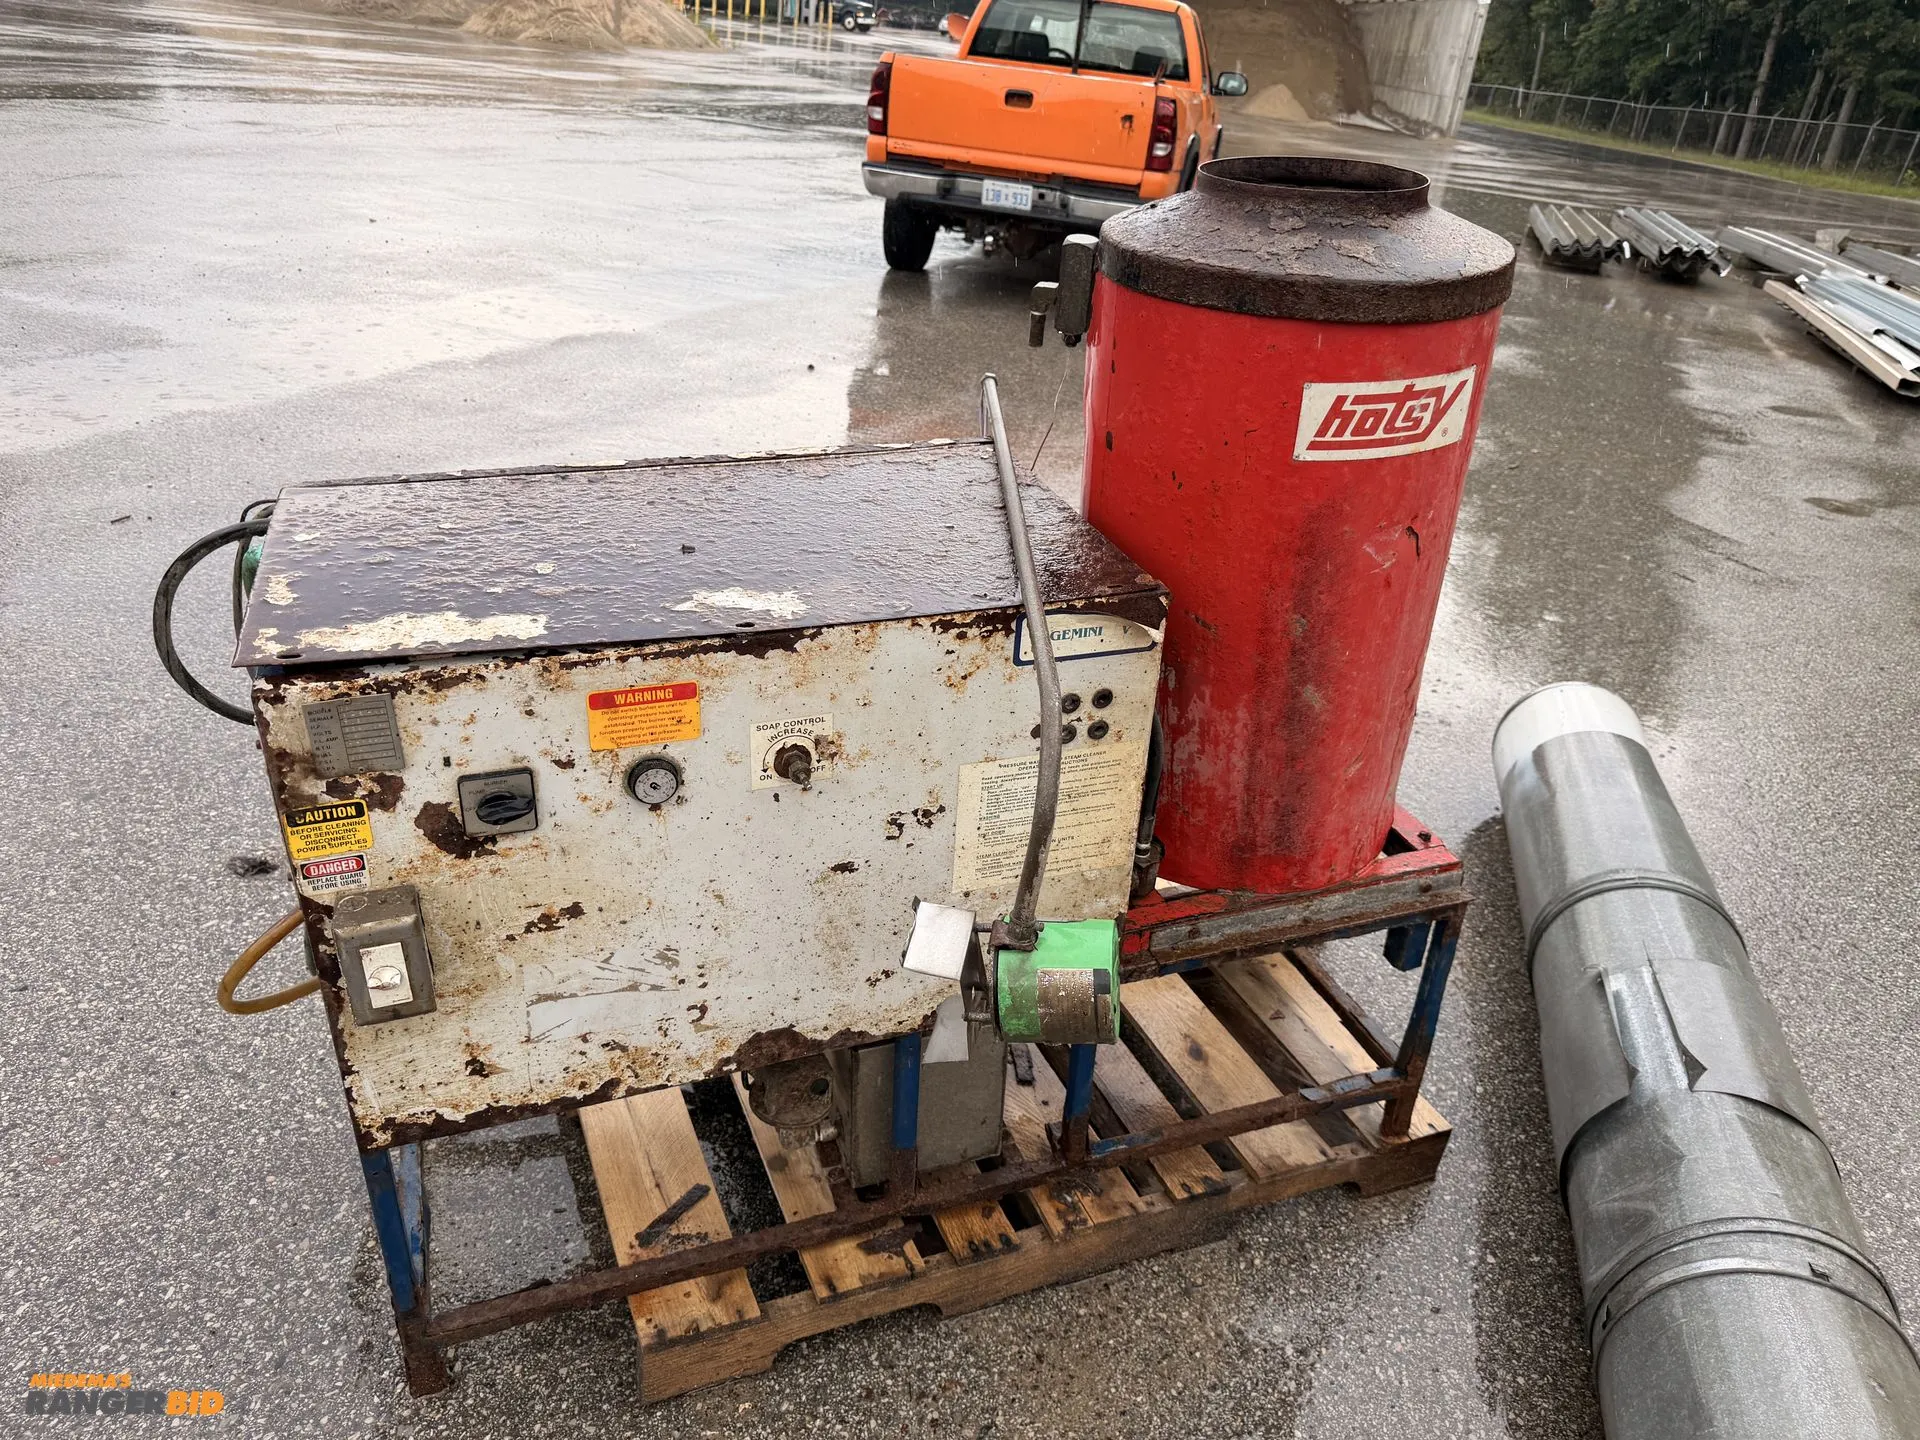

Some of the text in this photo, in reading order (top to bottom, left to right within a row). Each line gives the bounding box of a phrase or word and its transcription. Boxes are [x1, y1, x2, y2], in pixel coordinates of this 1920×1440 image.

[1308, 379, 1469, 450] hotsy
[1050, 626, 1103, 641] GEMINI
[613, 688, 673, 705] WARNING
[756, 716, 826, 732] SOAP CONTROL
[767, 727, 814, 743] INCREASE
[1082, 750, 1106, 758] CLEANER
[810, 765, 826, 774] OFF
[295, 806, 356, 824] CAUTION
[290, 820, 367, 836] BEFORE CLEANING
[296, 838, 368, 854] POWER SUPPLIES
[305, 834, 356, 846] DISCONNECT
[310, 859, 358, 876] DANGER
[308, 872, 364, 886] REPLACE GUARD
[312, 878, 362, 891] BEFORE USING
